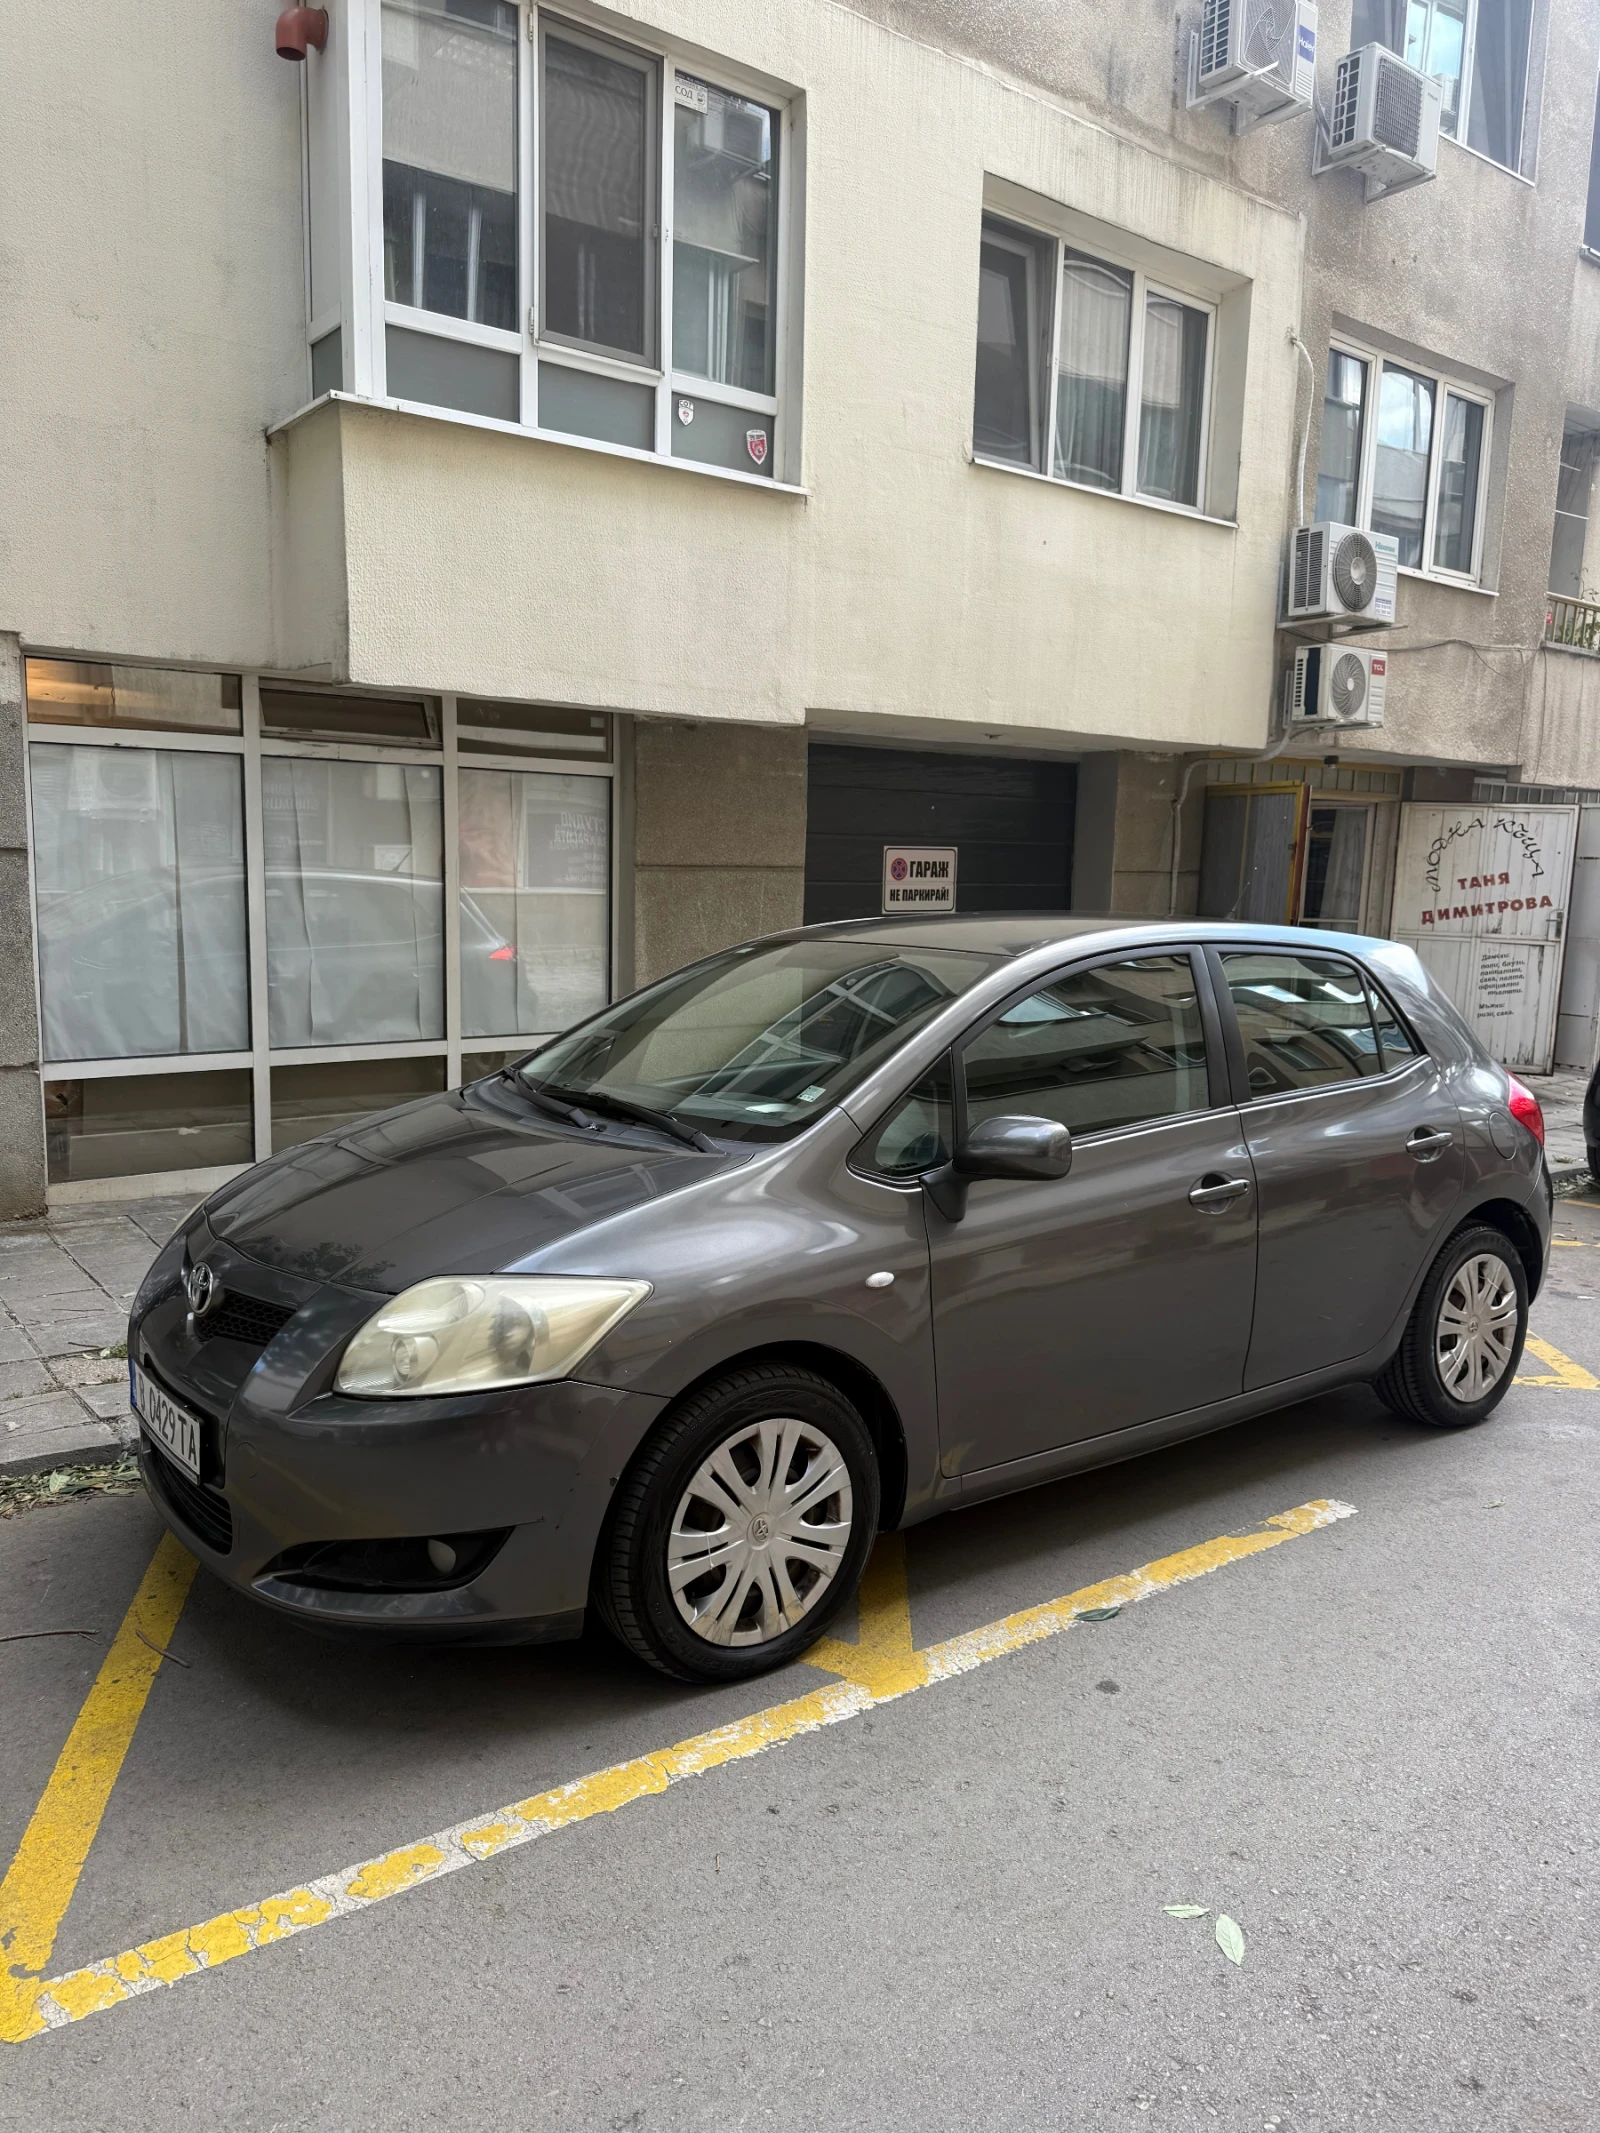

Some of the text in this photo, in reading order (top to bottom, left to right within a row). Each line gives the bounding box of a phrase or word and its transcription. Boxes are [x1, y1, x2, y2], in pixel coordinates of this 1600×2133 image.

[1298, 36, 1315, 52] Haier
[675, 85, 693, 100] СОД
[1375, 541, 1396, 553] Hisense
[1373, 663, 1384, 672] TCL
[909, 861, 949, 878] ГАРАЖ
[1457, 872, 1510, 890] ТАНЯ
[889, 886, 949, 901] НЕ ПАРКИРАЙ!
[1421, 895, 1553, 925] ДИМИТРОВА
[149, 1387, 176, 1445] 0429
[178, 1414, 197, 1466] TA
